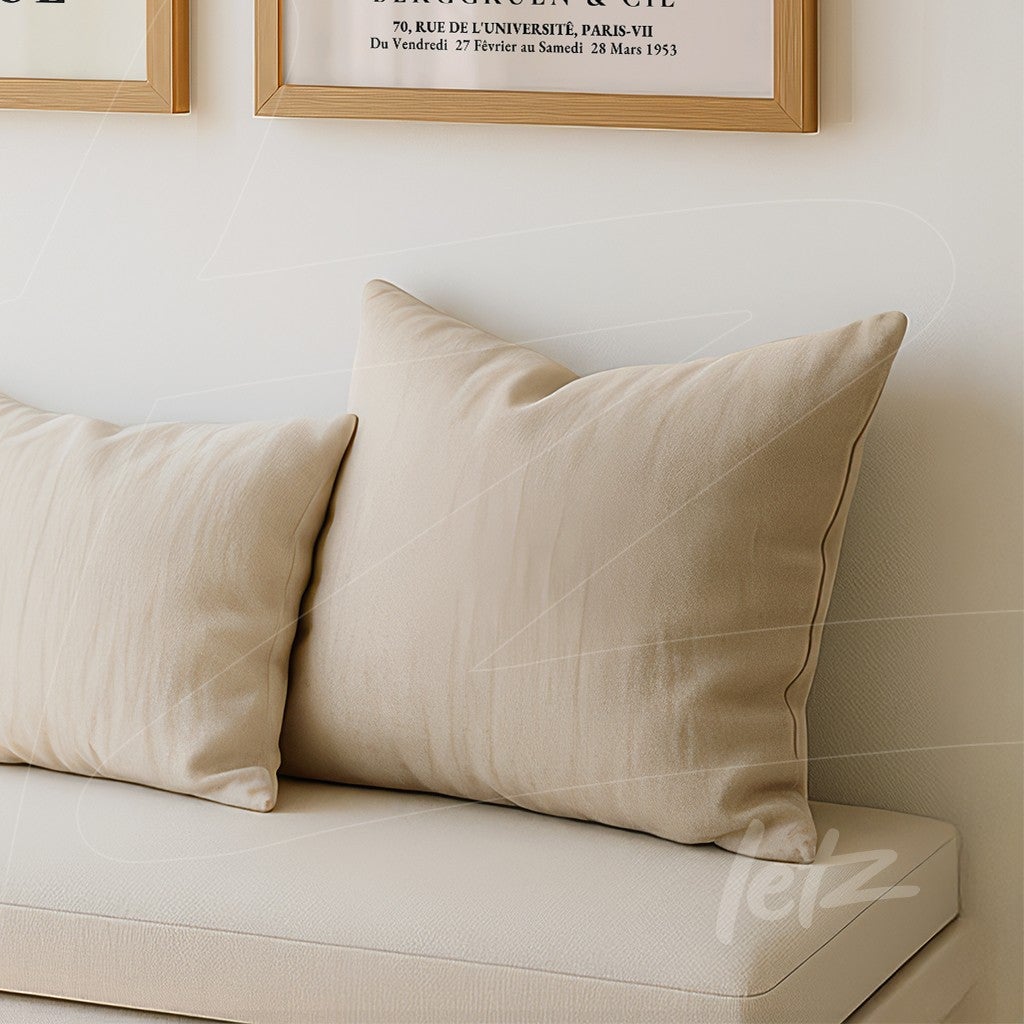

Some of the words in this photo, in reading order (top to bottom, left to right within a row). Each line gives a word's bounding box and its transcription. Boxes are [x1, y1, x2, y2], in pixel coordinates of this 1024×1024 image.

[392, 20, 413, 35] 70,
[414, 20, 446, 34] RUE
[448, 20, 469, 34] DE
[581, 24, 654, 38] PARIS-VII
[369, 36, 389, 50] Du
[391, 37, 448, 51] Vendredi
[454, 39, 471, 52] 27
[520, 44, 536, 54] au
[538, 40, 584, 55] Samedi
[590, 42, 607, 55] 28
[609, 42, 643, 56] Mars
[646, 43, 678, 58] 1953
